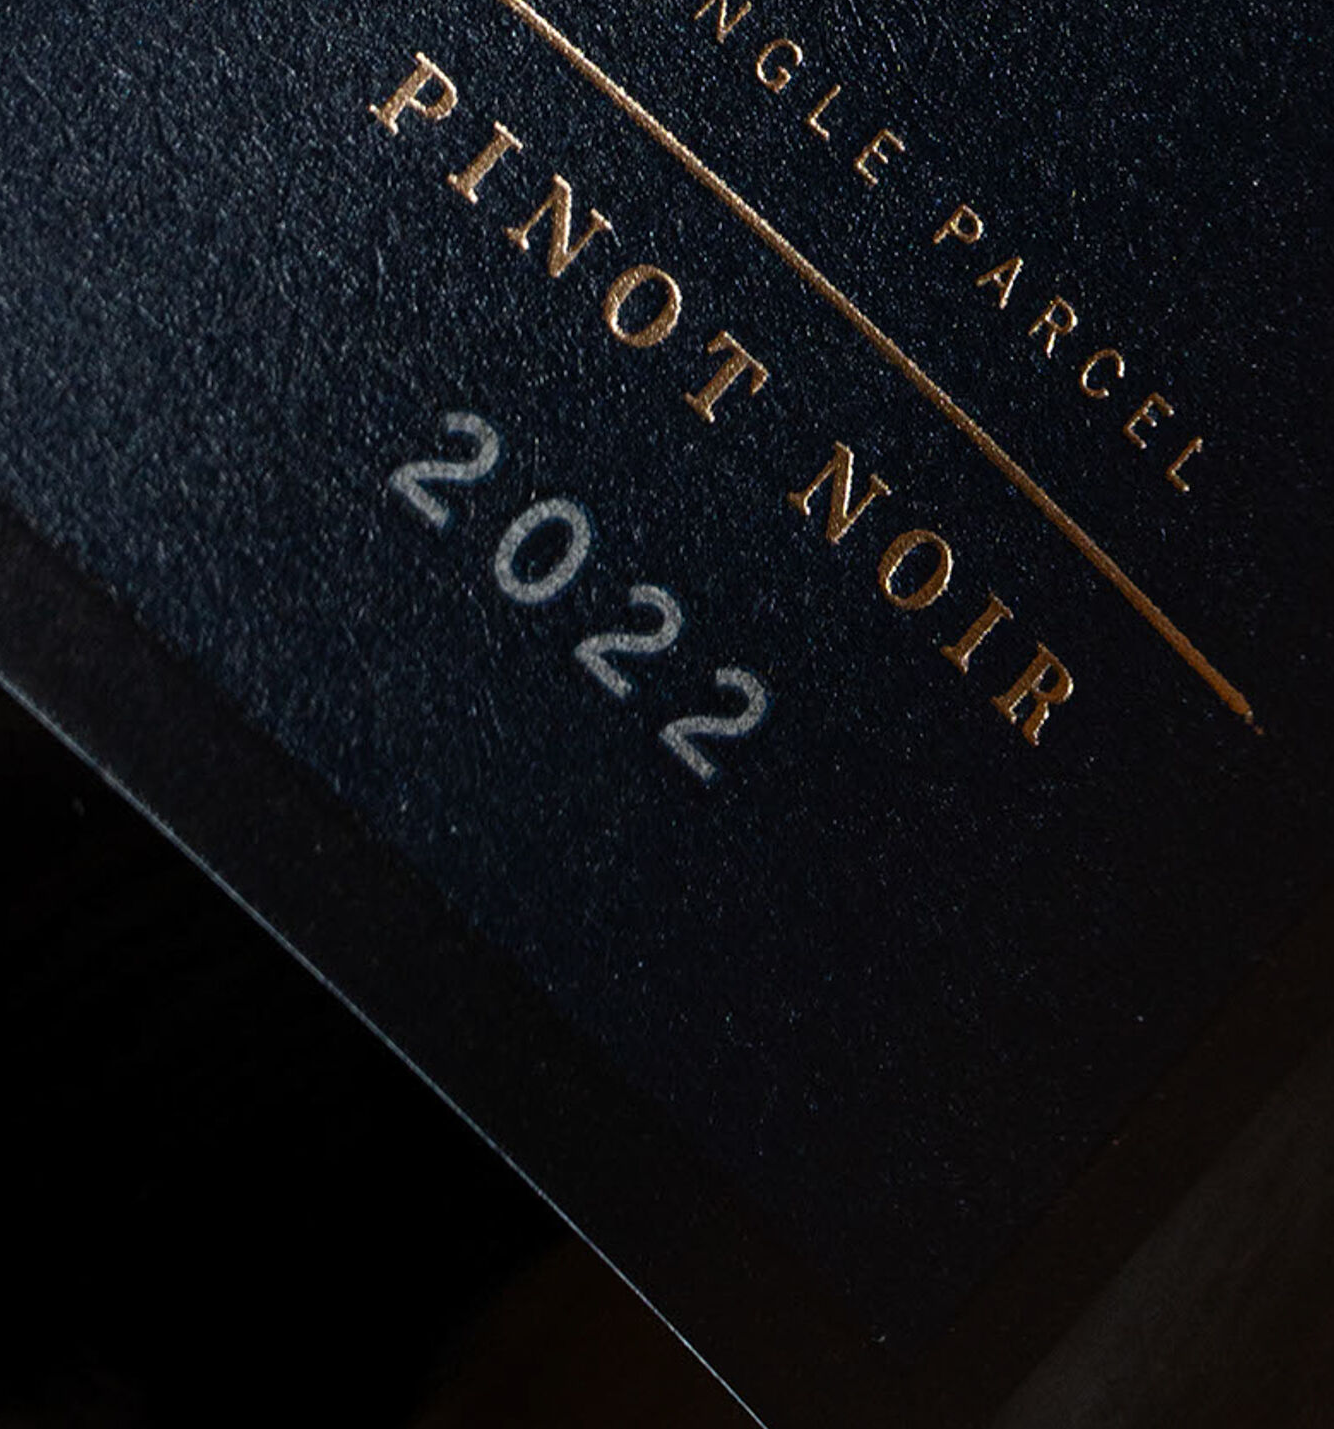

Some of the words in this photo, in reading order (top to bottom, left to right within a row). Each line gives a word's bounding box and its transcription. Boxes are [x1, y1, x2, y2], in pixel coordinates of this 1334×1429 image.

[369, 52, 770, 424] PINOT
[788, 442, 1075, 746] NOIR
[933, 204, 1208, 494] PARCEL
[388, 412, 770, 779] 2022
